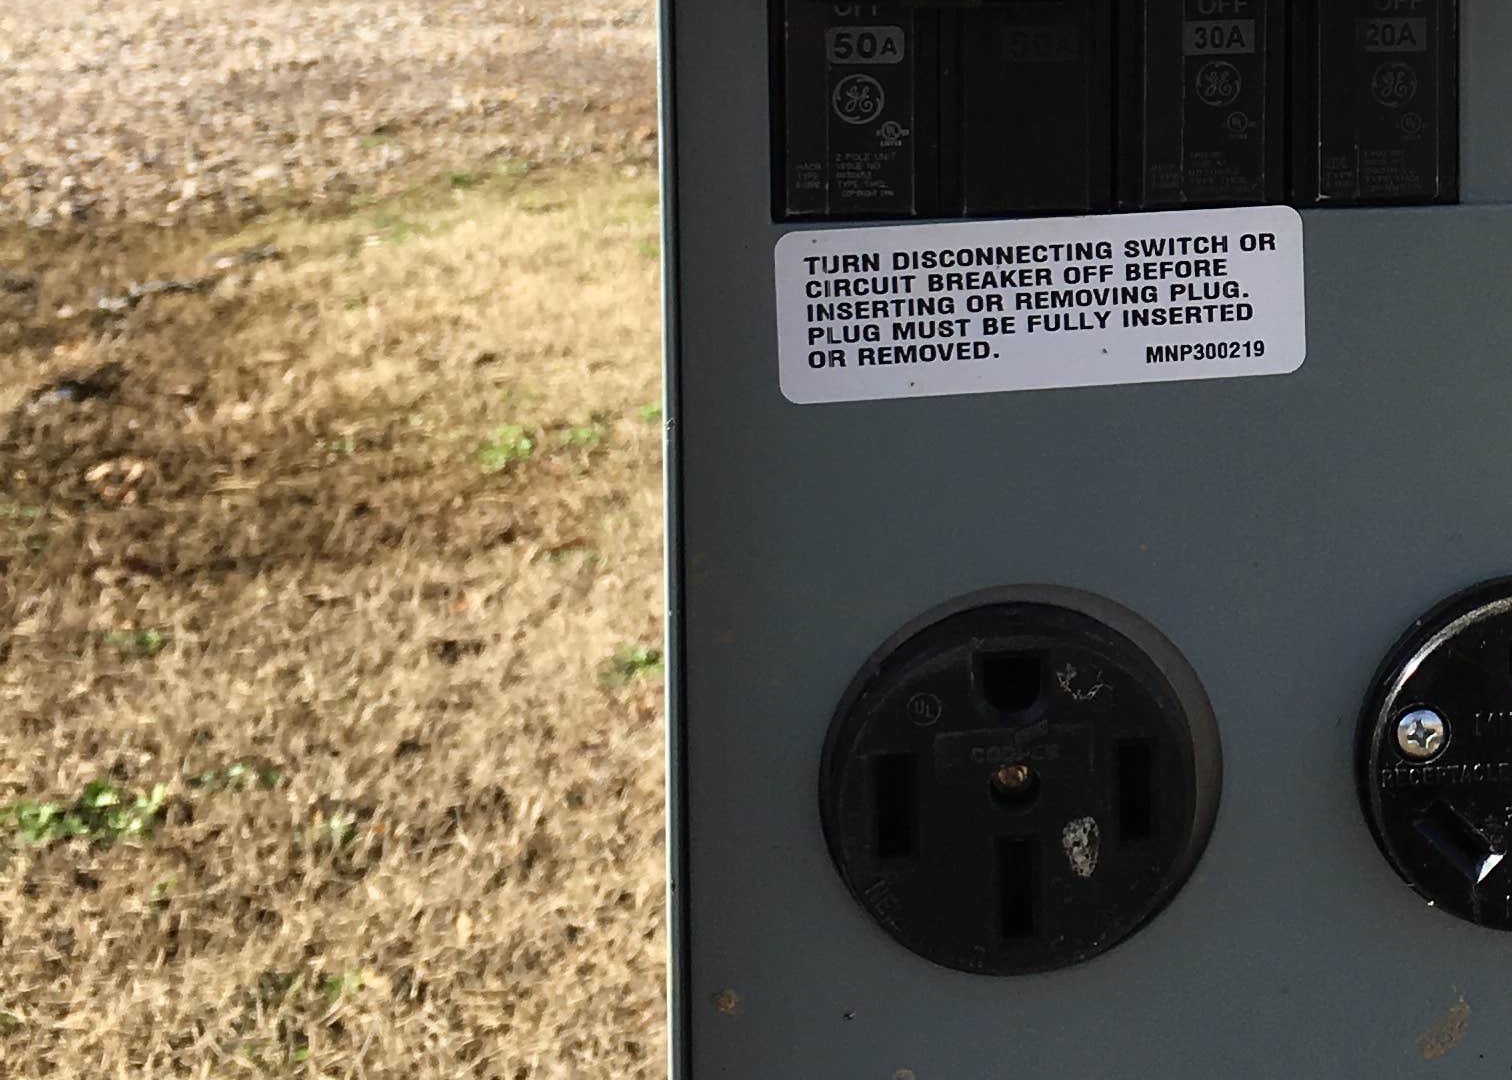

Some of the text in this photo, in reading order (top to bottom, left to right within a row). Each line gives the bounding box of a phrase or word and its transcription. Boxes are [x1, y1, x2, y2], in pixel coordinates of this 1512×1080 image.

[834, 31, 898, 59] 50A
[1194, 24, 1246, 50] 30A
[1367, 23, 1417, 48] 20A
[802, 233, 1276, 276] TURN DISCONNECTING SWITCH OR
[805, 258, 1228, 299] CIRCUIT BREAKER OFF BEFORE
[806, 282, 1250, 323] INSERTING OR REMOVING PLUG.
[807, 303, 1254, 346] PLUG MUST BE FULLY INSERTED
[807, 342, 1000, 369] OR REMOVED.
[1145, 339, 1265, 364] MNP300219
